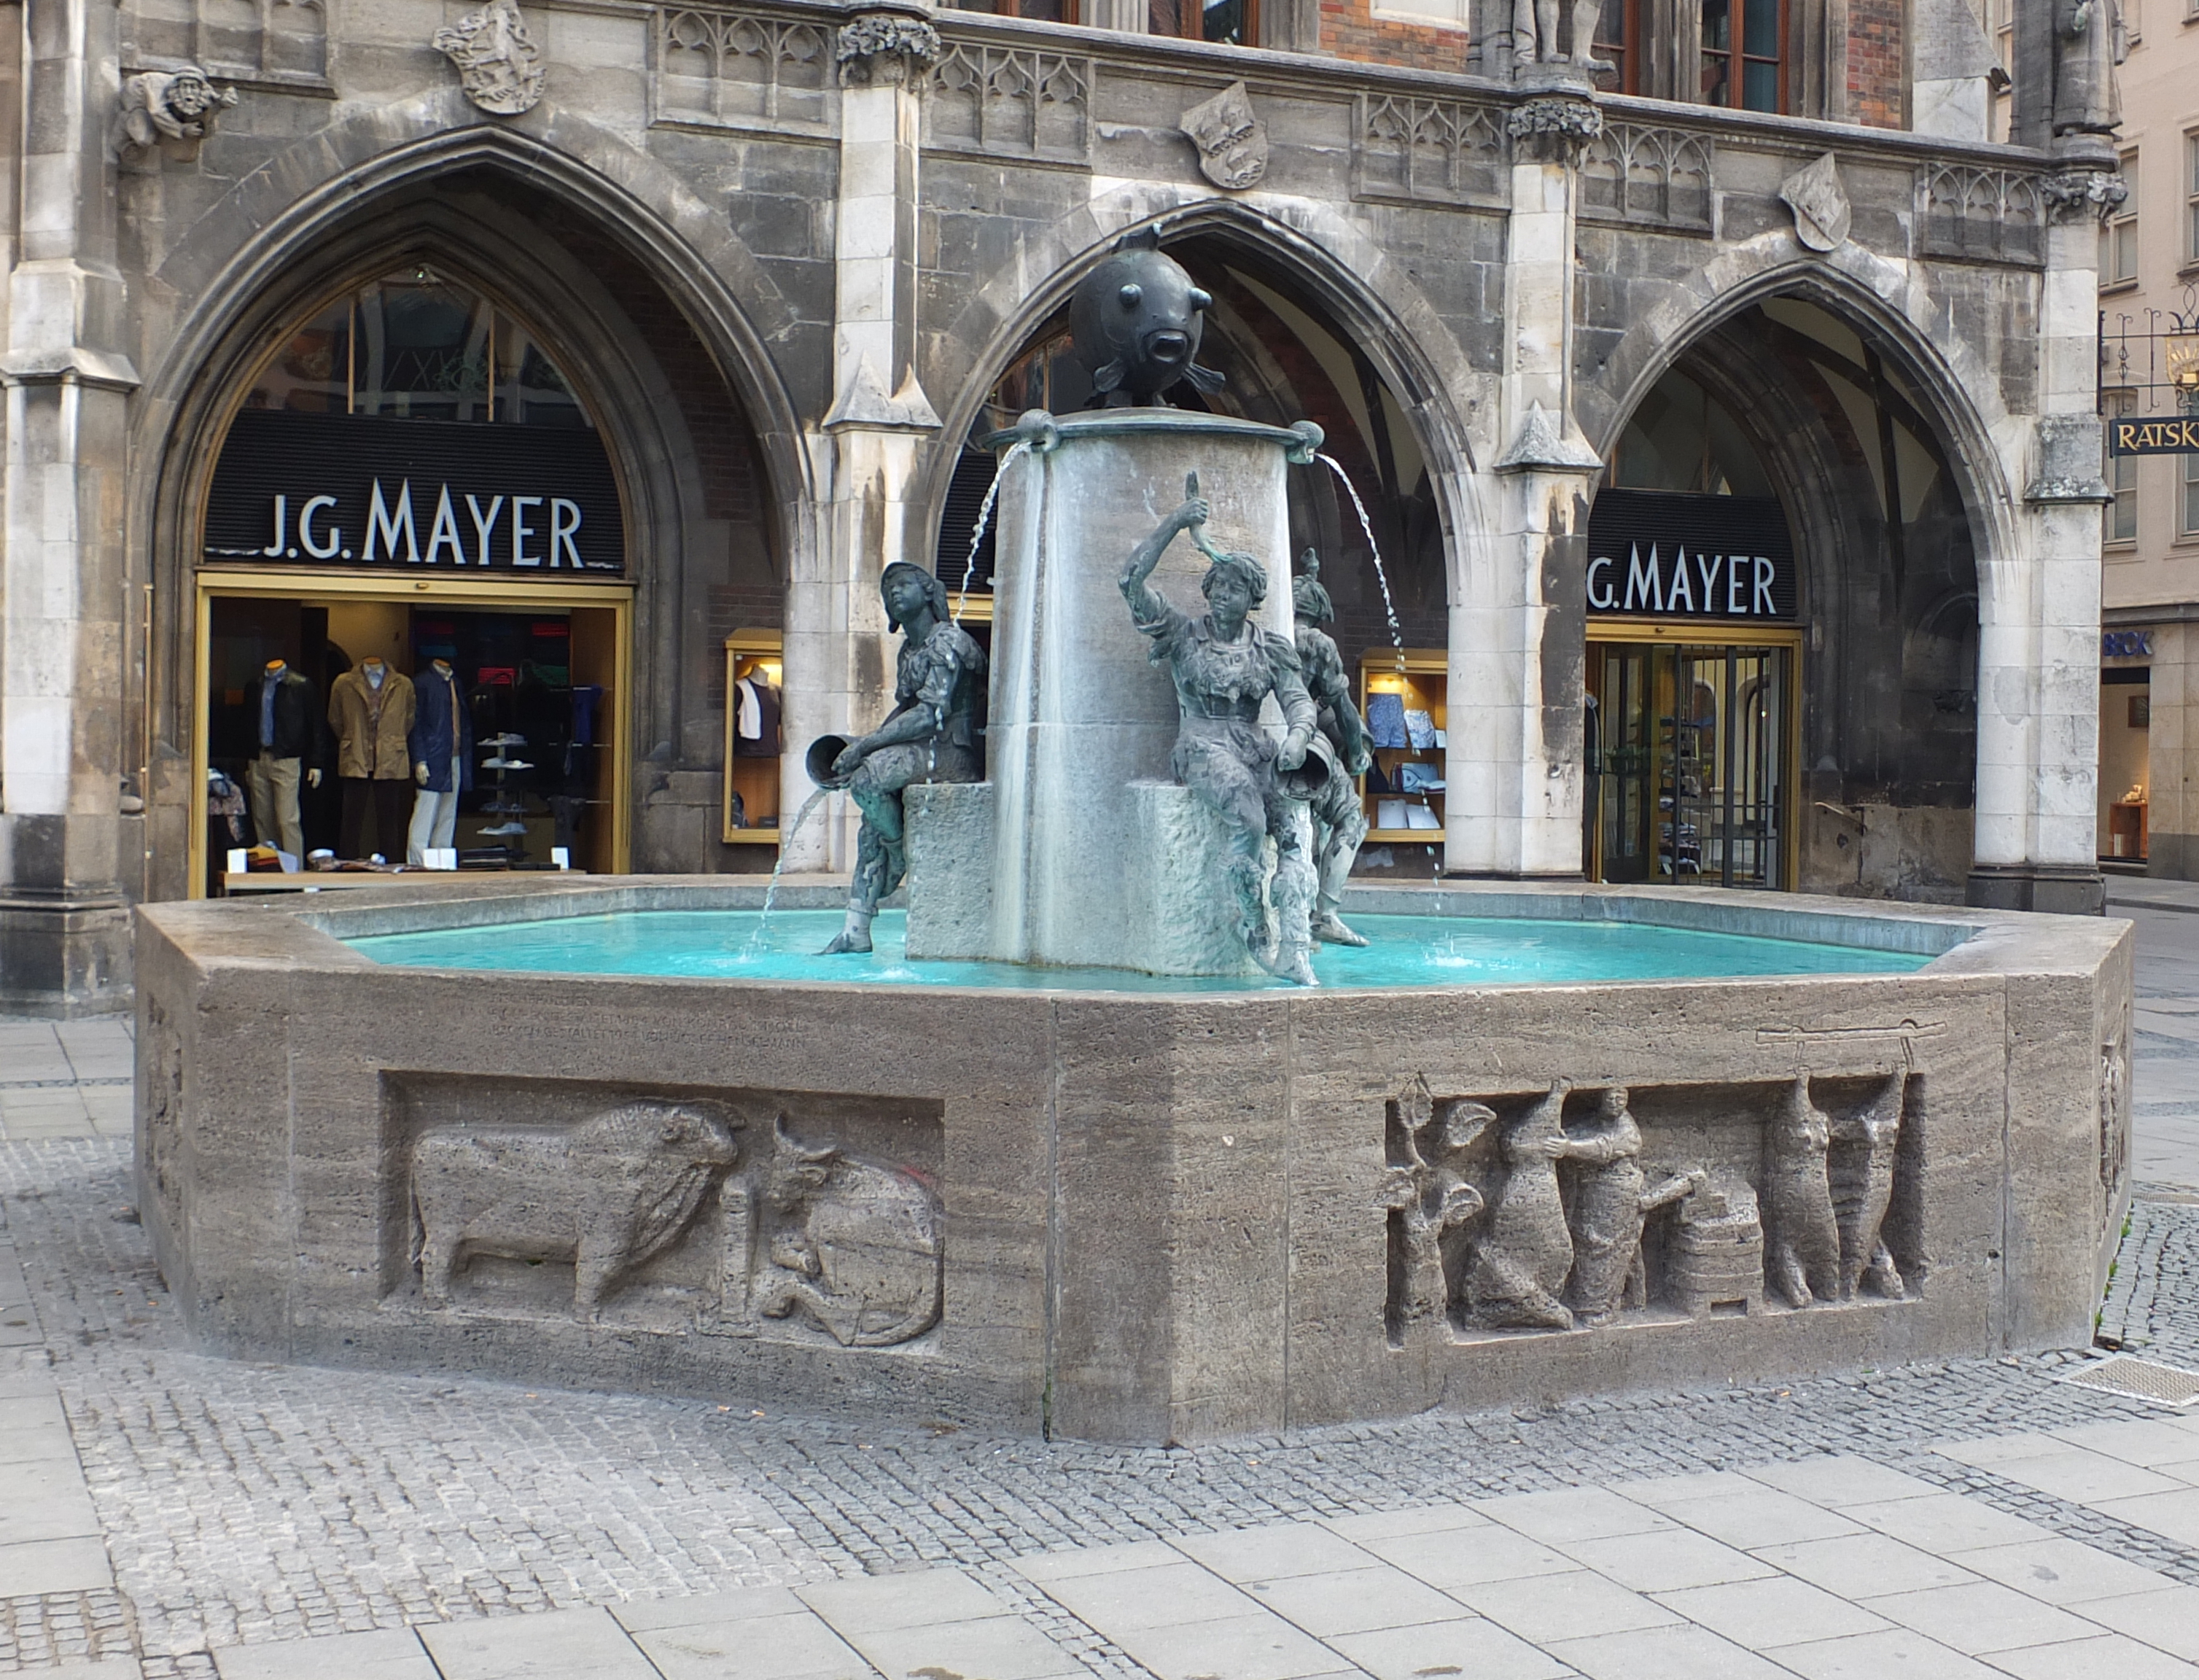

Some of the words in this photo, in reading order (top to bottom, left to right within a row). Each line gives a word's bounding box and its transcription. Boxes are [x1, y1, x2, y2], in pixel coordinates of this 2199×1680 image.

[2117, 421, 2199, 451] RATSK
[263, 494, 352, 559] J.G.
[361, 477, 584, 569] MAYER
[1624, 541, 1777, 615] MAYER
[2103, 631, 2152, 656] BECK
